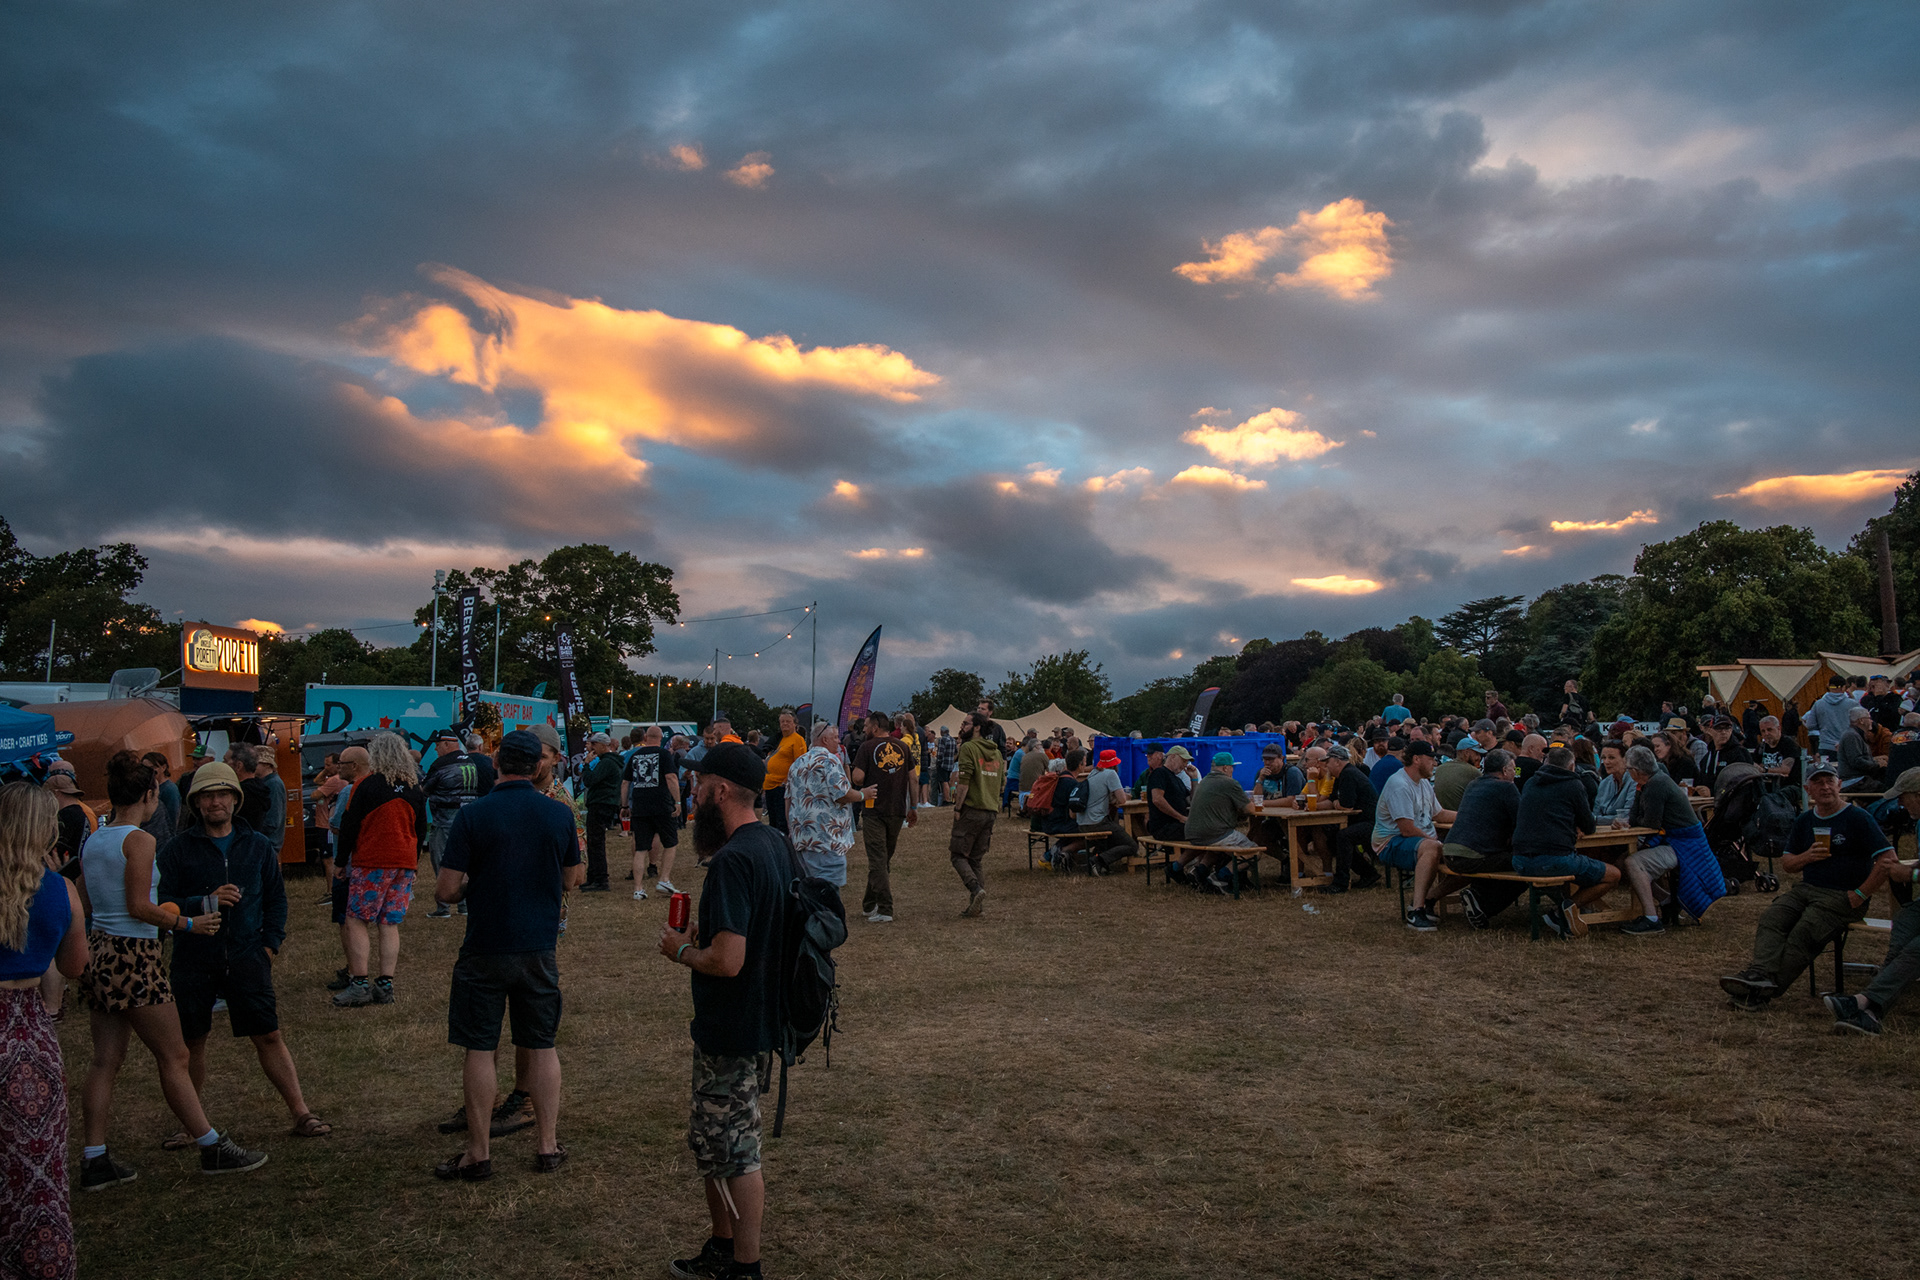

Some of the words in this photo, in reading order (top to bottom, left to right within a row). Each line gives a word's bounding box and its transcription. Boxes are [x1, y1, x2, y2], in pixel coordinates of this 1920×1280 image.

[463, 596, 475, 636] BEER
[196, 647, 217, 664] PORETTI
[463, 639, 469, 656] IN
[463, 659, 473, 668] 7
[569, 671, 584, 713] SHEEP
[850, 664, 869, 707] DISCO
[503, 703, 520, 720] CRAFT
[522, 705, 533, 720] BAR
[19, 734, 36, 748] CRAFT
[37, 733, 48, 746] KEG
